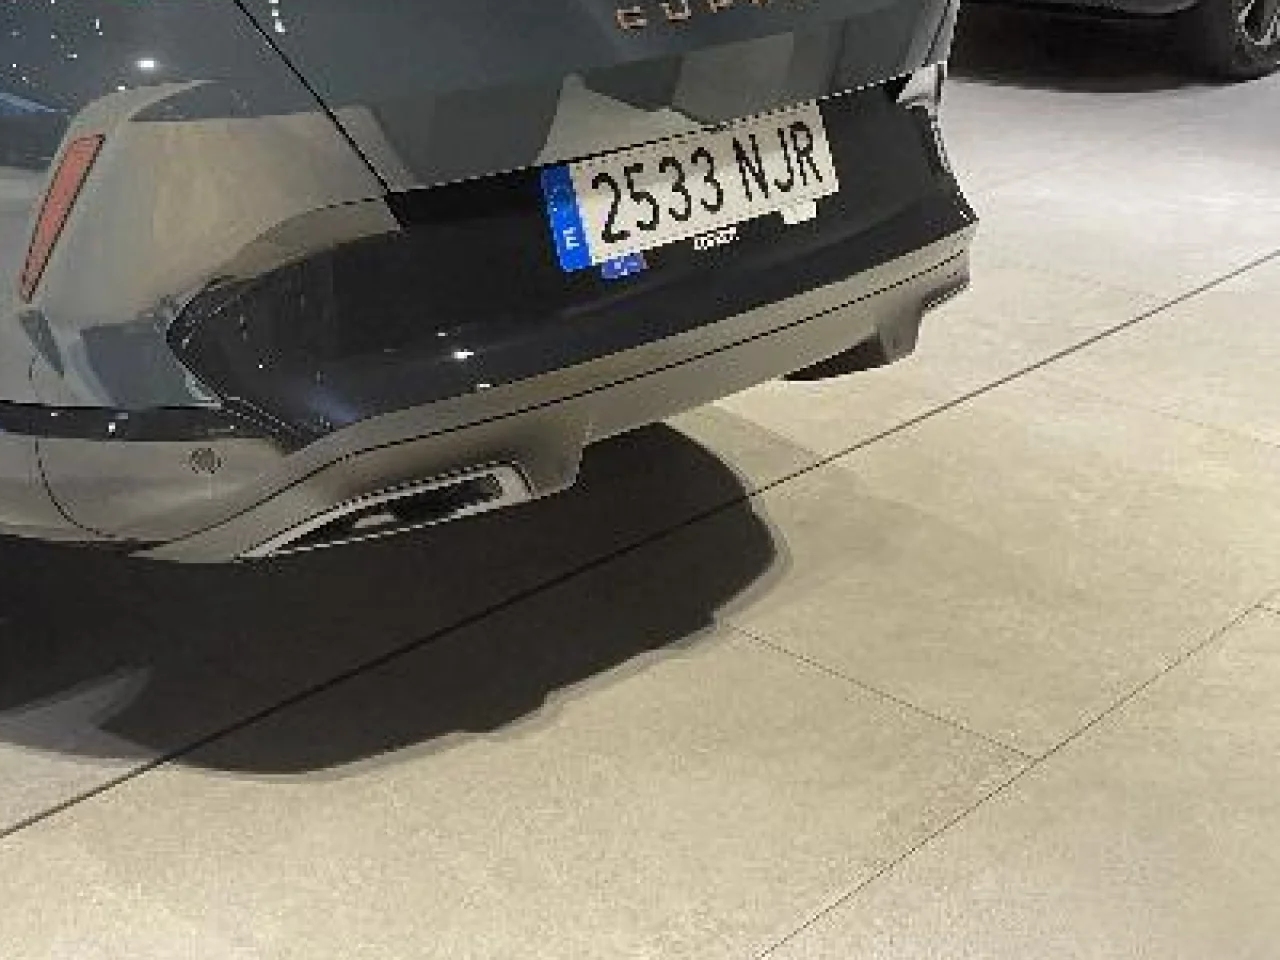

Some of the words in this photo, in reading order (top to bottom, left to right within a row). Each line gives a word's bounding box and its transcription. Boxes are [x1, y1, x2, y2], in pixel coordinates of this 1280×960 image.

[591, 146, 724, 243] 2533
[732, 121, 824, 202] NJR
[562, 226, 580, 251] E
